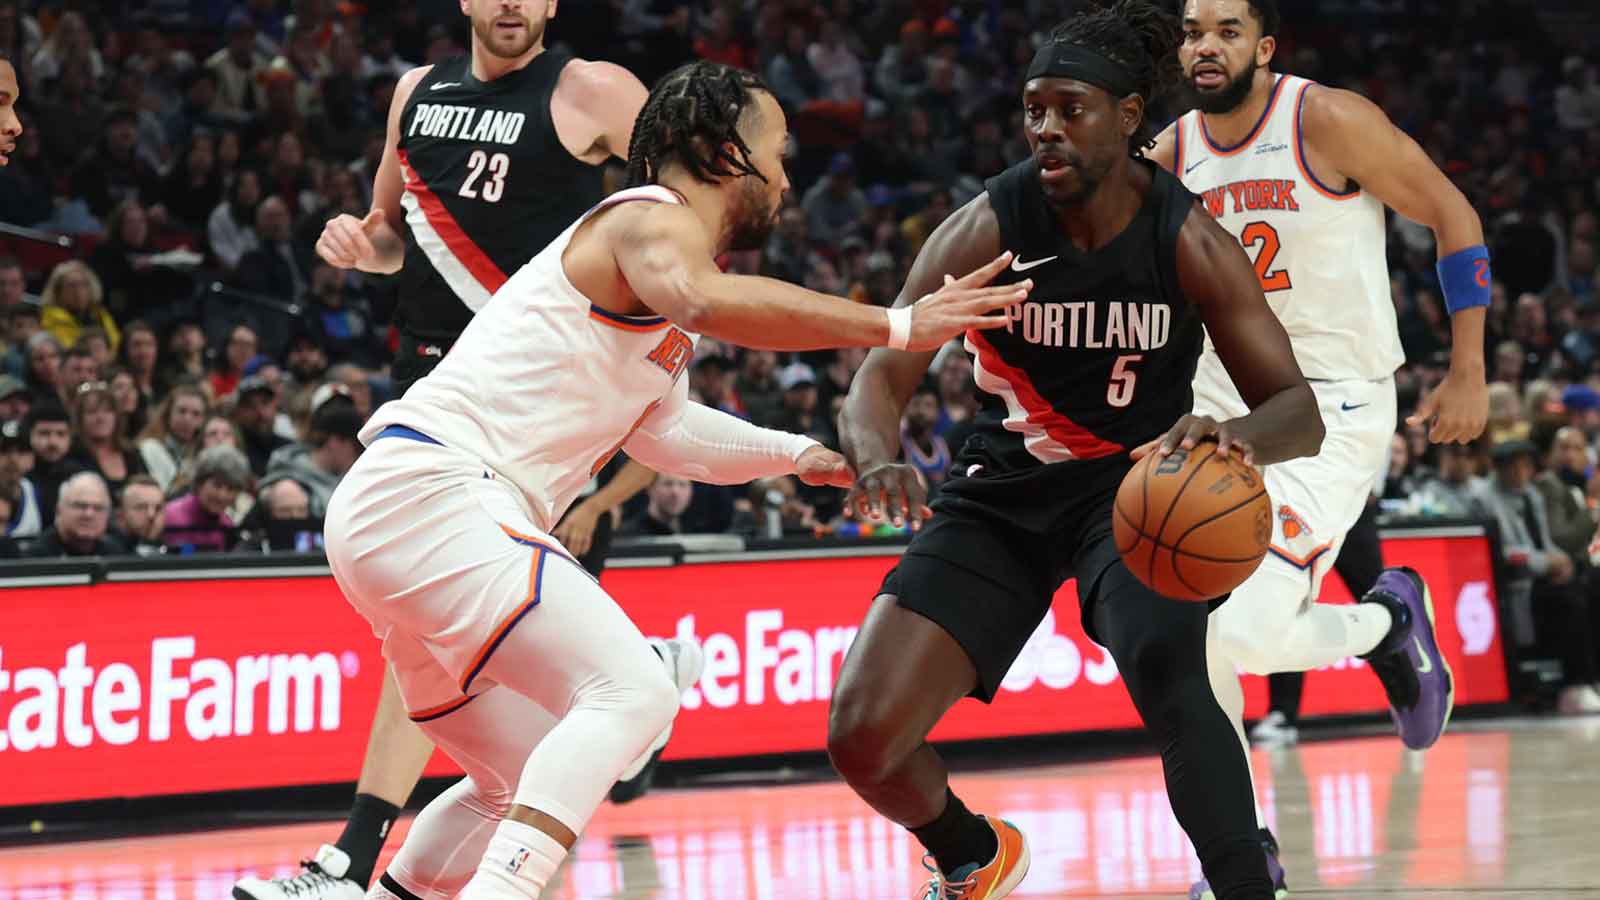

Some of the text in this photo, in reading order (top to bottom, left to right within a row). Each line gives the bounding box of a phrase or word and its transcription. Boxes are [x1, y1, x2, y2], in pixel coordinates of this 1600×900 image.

[408, 103, 526, 145] PORTLAND
[458, 149, 510, 203] 23
[1226, 178, 1300, 212] YORK
[1004, 301, 1171, 350] PORTLAND
[1107, 354, 1143, 408] 5
[148, 635, 342, 741] Farm
